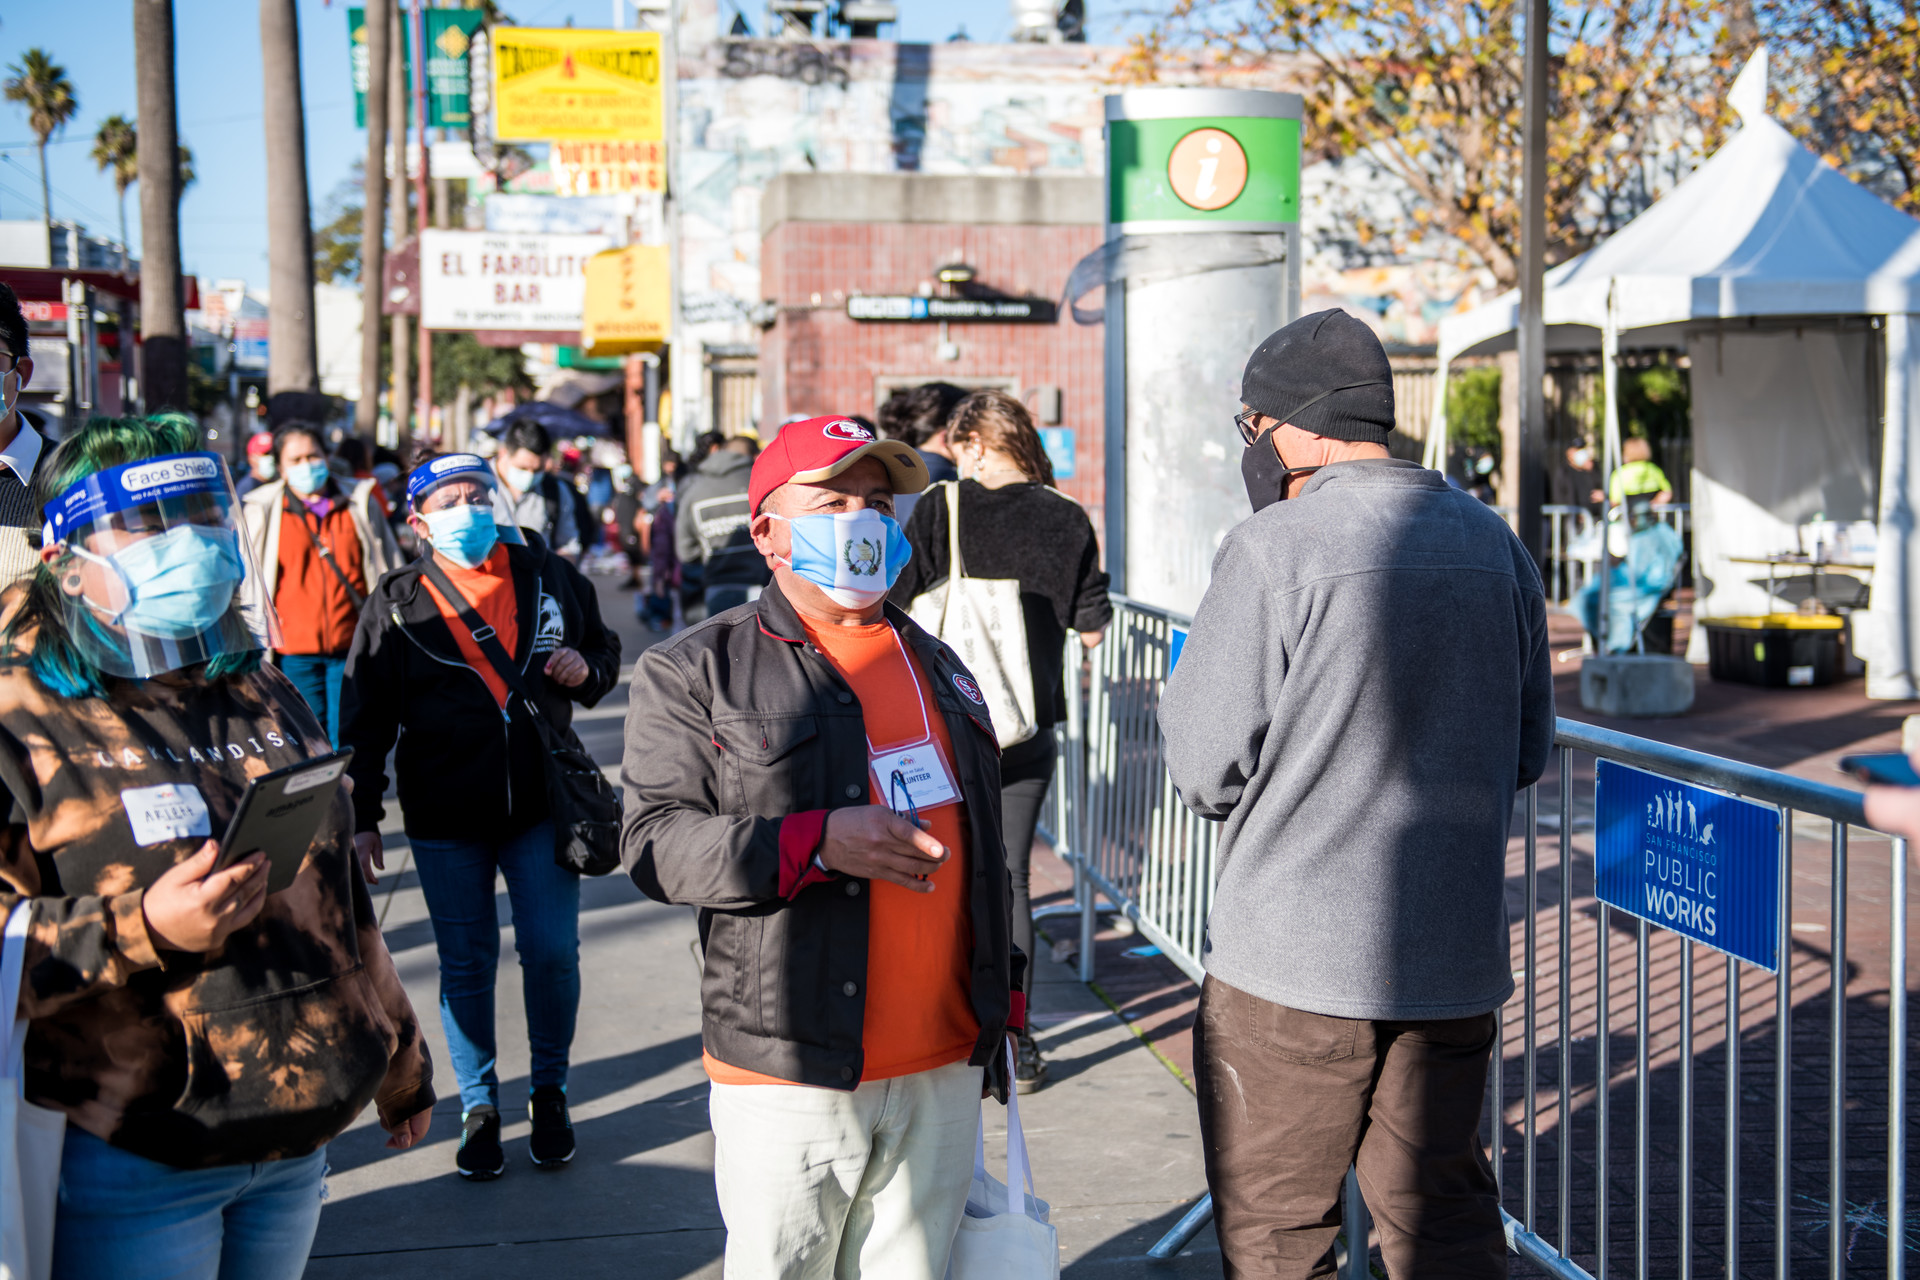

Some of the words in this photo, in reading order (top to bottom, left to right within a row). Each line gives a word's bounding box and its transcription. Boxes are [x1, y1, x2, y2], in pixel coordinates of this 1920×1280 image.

[441, 253, 467, 276] EL
[494, 282, 541, 304] BAR
[127, 469, 170, 488] Face
[173, 462, 215, 478] Shield
[1646, 832, 1662, 848] SAN
[1665, 838, 1717, 866] FRANCISCO
[1645, 849, 1716, 899] PUBLIC
[1645, 882, 1716, 936] WORKS
